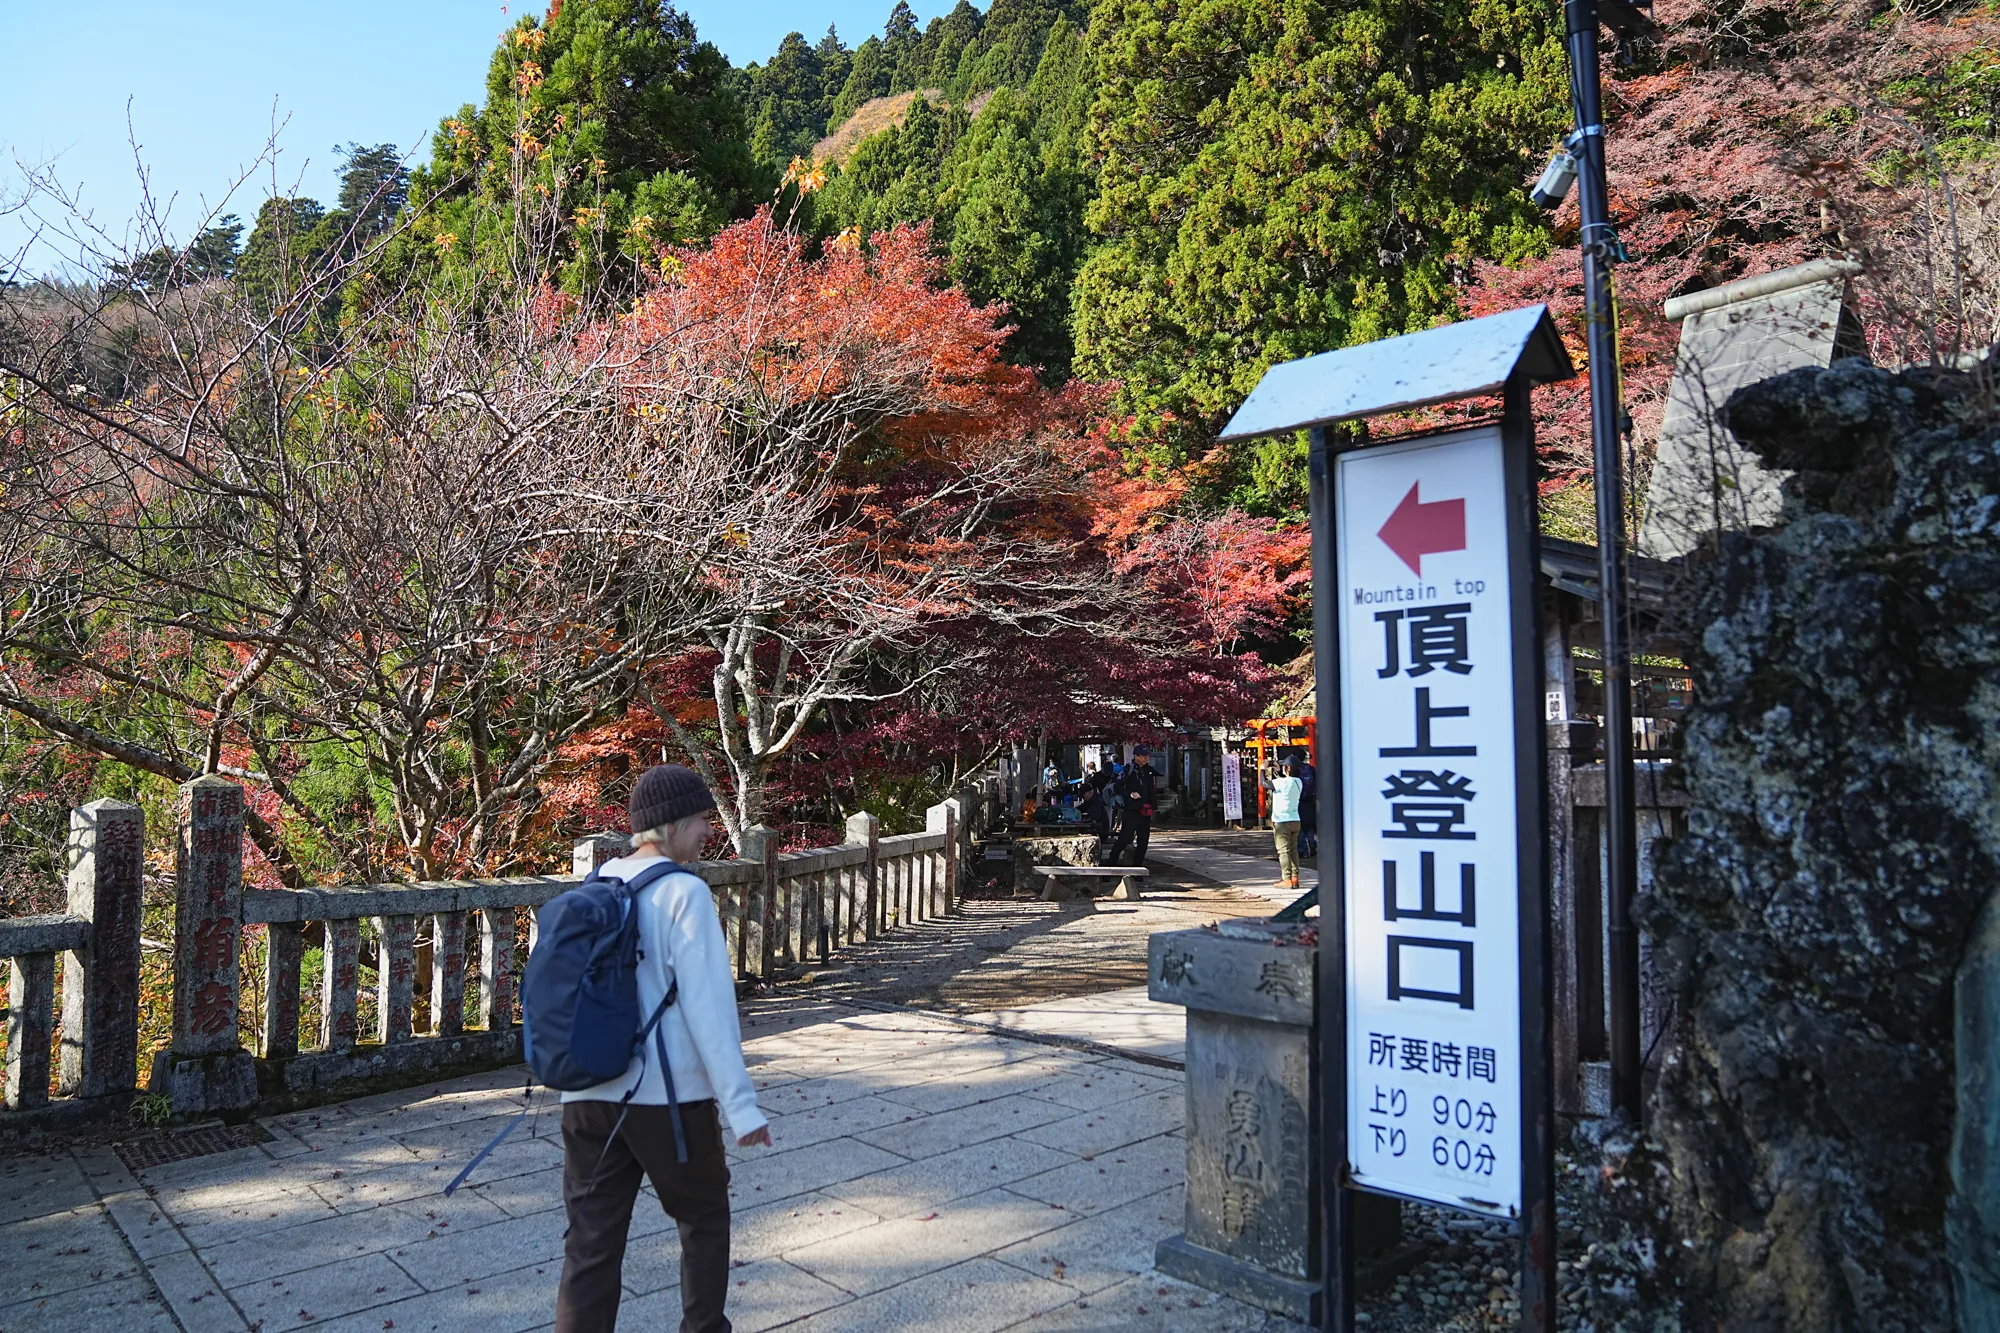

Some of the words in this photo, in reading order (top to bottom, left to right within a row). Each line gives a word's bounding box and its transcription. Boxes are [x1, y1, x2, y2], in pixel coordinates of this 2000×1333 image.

[1354, 582, 1437, 606] Mountain
[1453, 578, 1486, 597] top
[1374, 602, 1477, 1010] 頂上登山口
[1368, 1033, 1497, 1084] 所要時間
[1369, 1084, 1408, 1118] 上り
[1432, 1095, 1497, 1135] 90分
[1369, 1124, 1408, 1158] 下り
[1432, 1136, 1497, 1177] 60分
